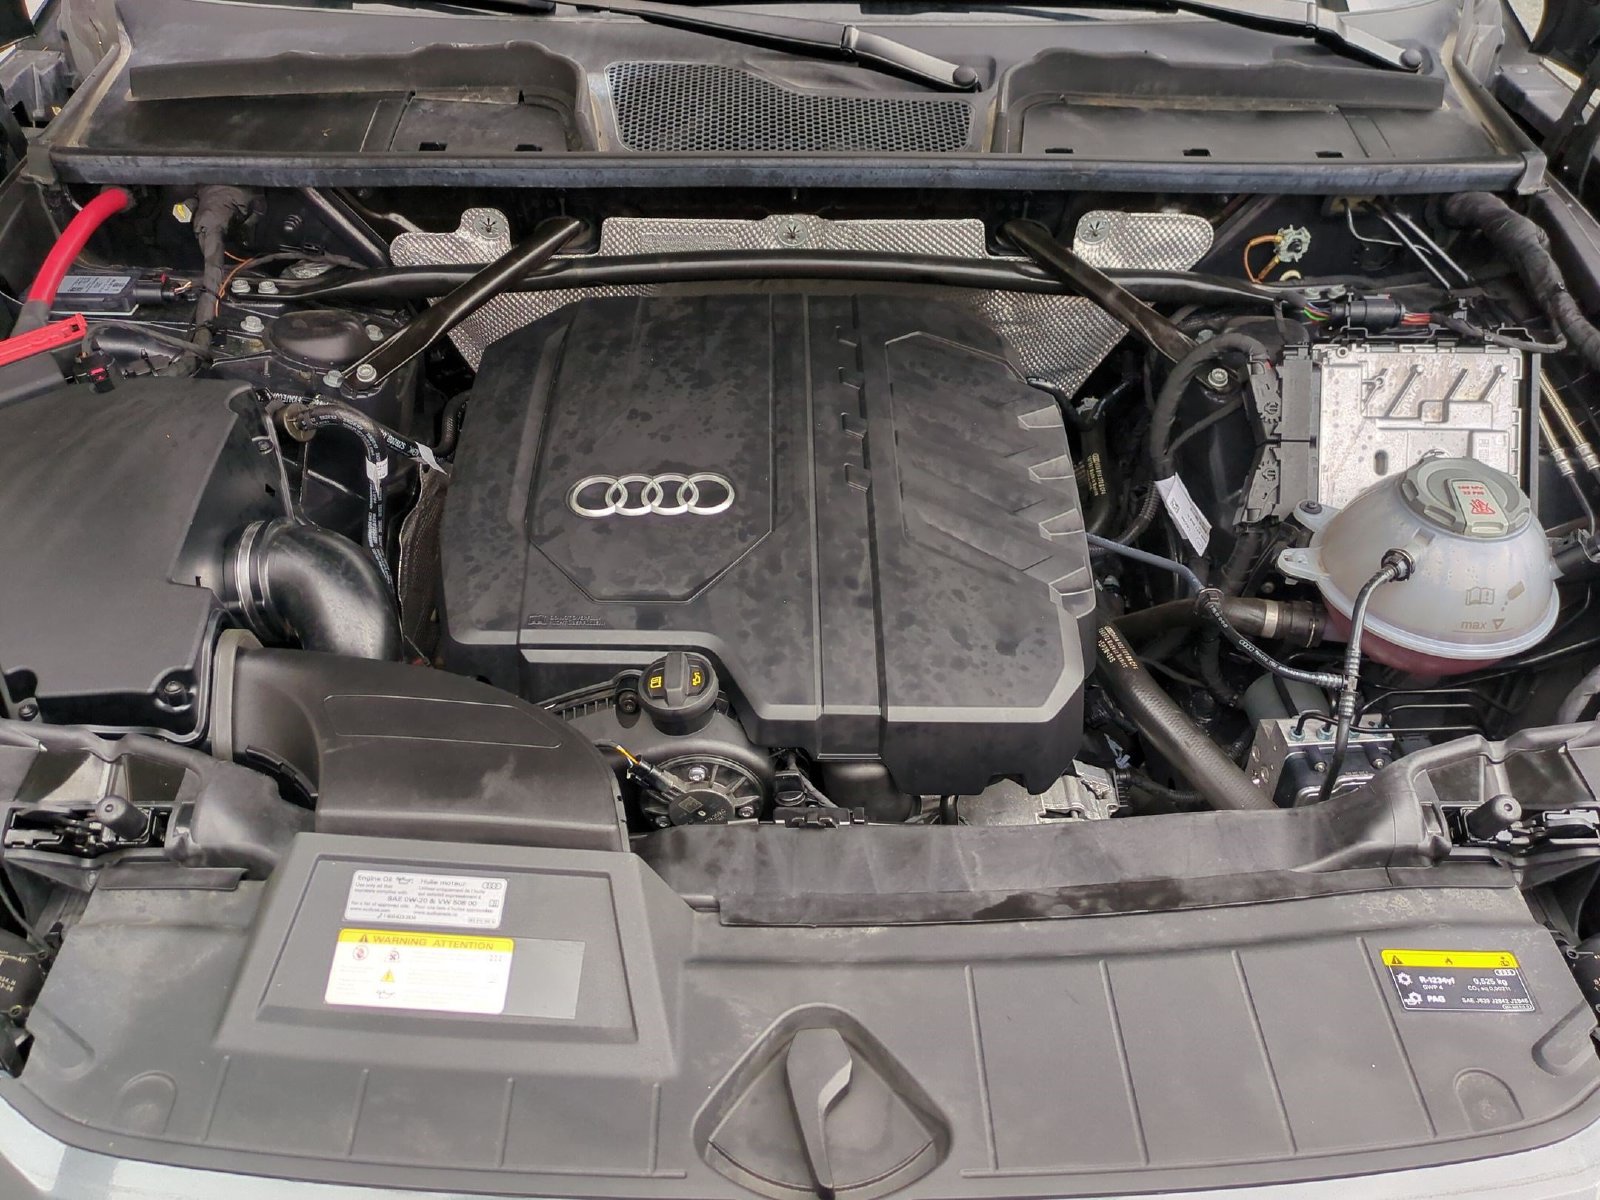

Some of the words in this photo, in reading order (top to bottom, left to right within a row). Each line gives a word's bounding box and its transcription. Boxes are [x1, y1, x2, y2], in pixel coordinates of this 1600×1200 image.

[1461, 621, 1487, 630] max
[357, 874, 381, 882] Engine
[373, 935, 428, 946] WARNING
[432, 939, 494, 950] ATTENTION
[1496, 978, 1508, 987] kg
[1427, 994, 1446, 1003] PAG
